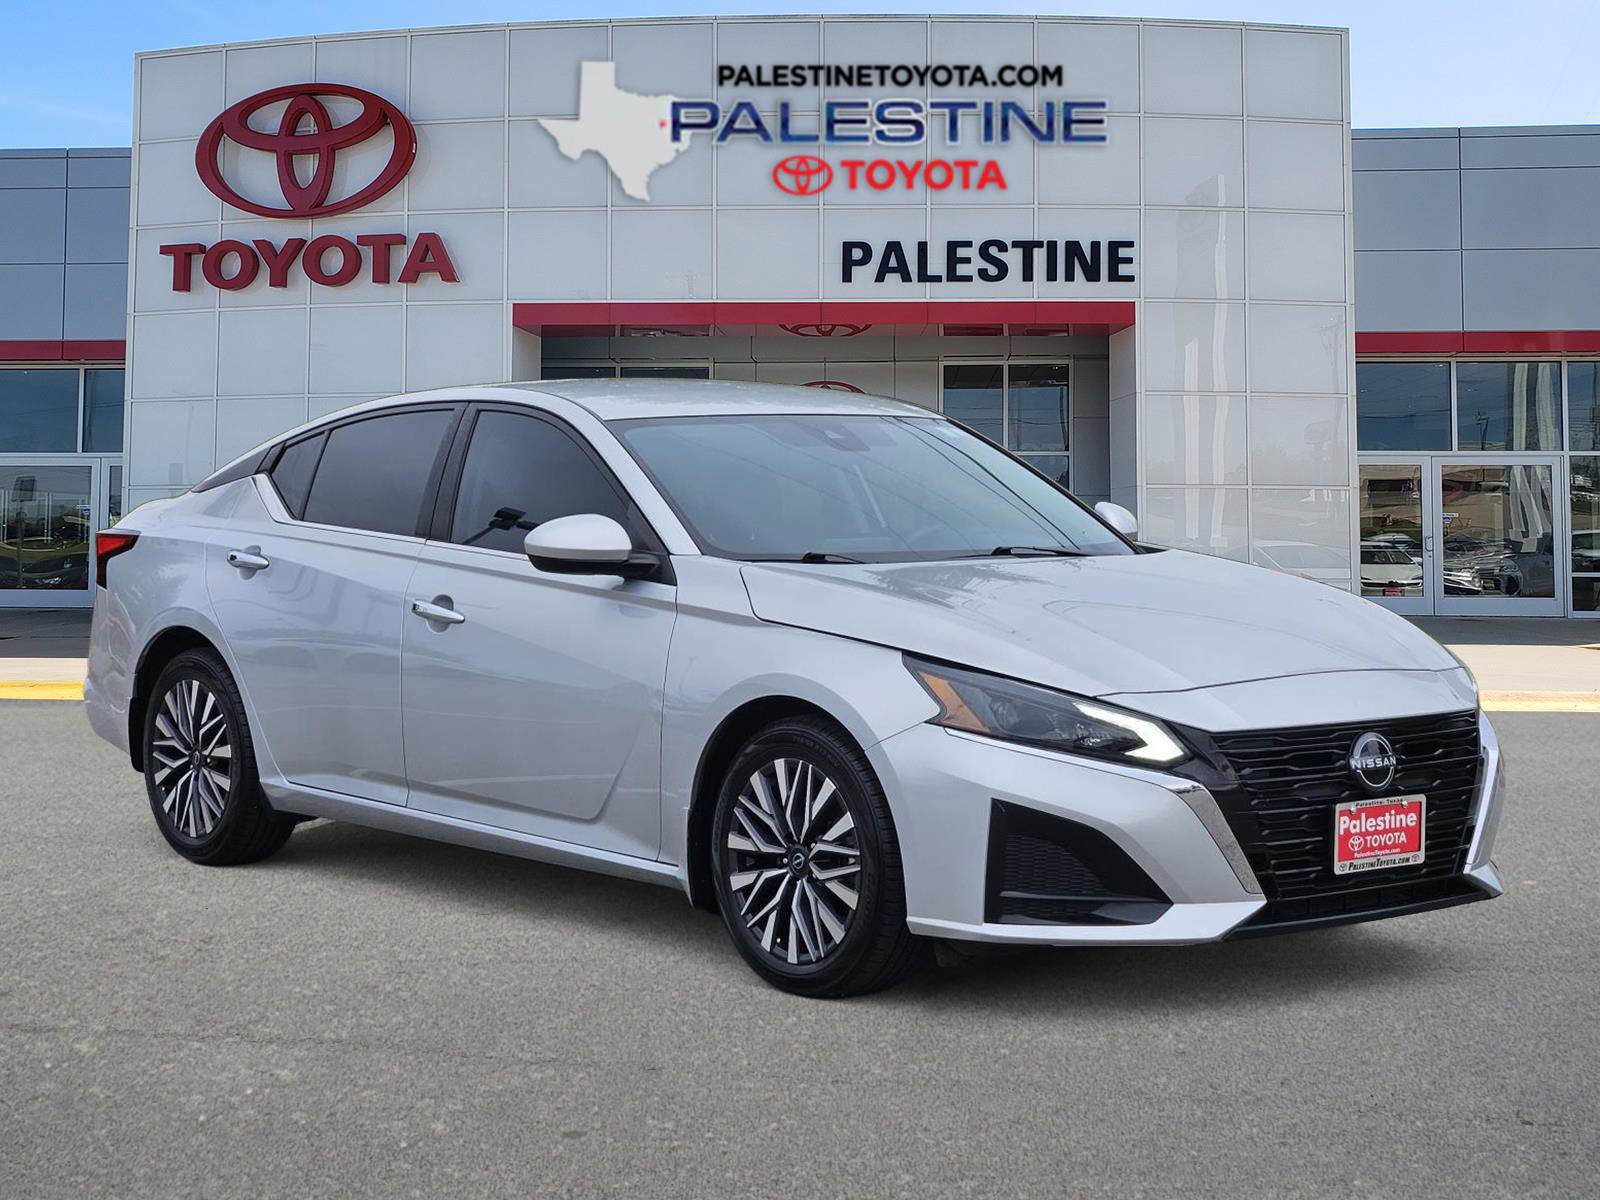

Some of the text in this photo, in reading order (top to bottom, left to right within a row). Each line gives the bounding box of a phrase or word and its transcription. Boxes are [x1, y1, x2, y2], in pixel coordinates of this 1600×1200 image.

[160, 232, 460, 292] TOYOTA
[841, 239, 1135, 283] PALESTINE
[1351, 757, 1396, 769] NISSAN
[1339, 809, 1417, 835] Palestine
[1365, 831, 1407, 847] TOYOTA
